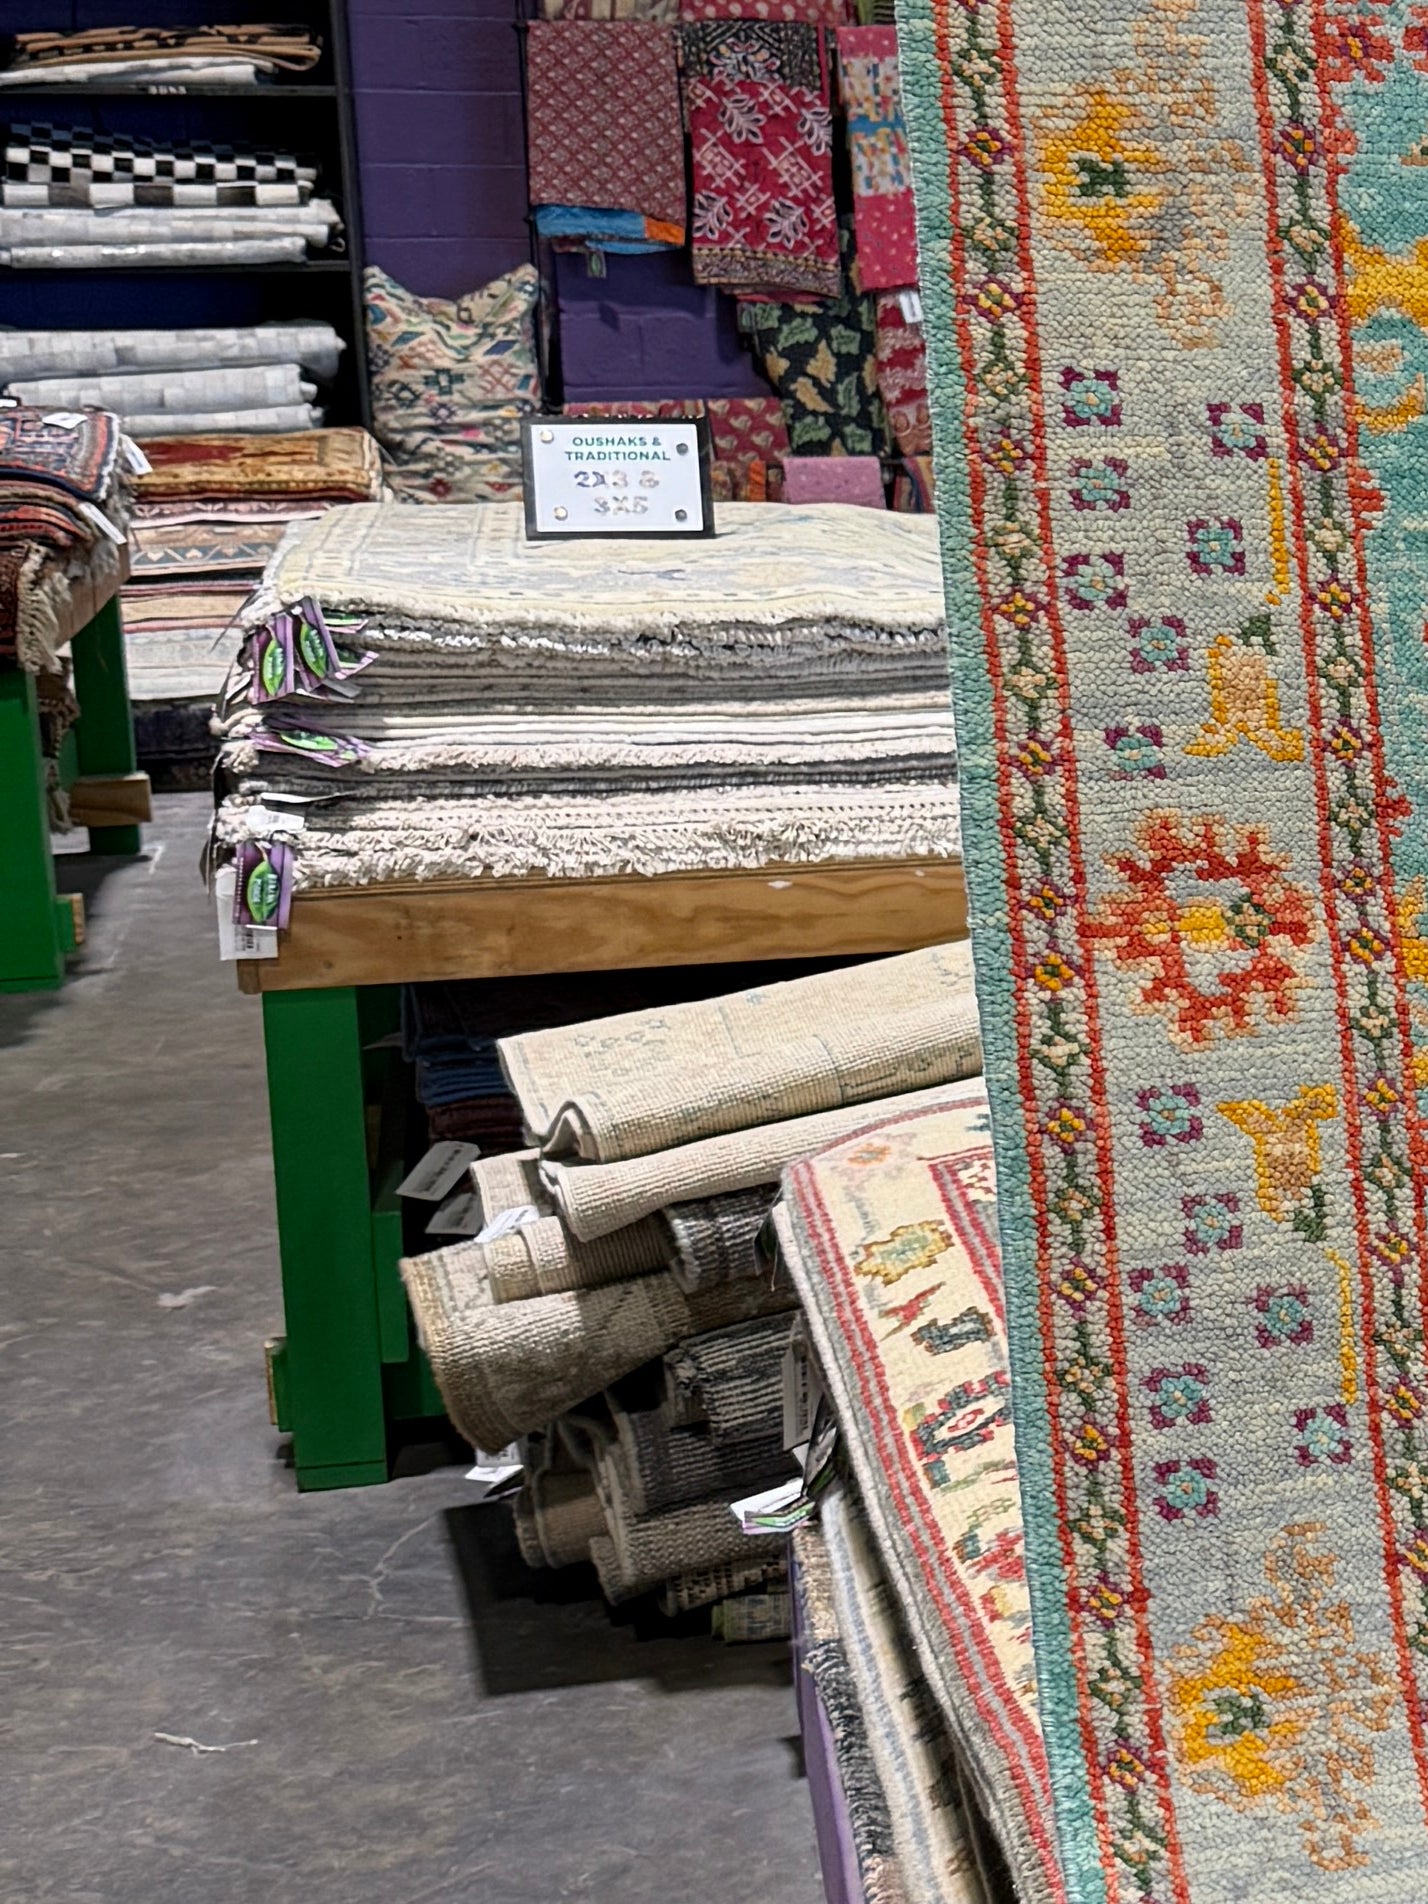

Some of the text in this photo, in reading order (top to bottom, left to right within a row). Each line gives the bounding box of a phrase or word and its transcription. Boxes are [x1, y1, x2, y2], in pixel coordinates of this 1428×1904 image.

[572, 436, 662, 447] OUSHAKS &
[564, 450, 671, 461] TRADITIONAL
